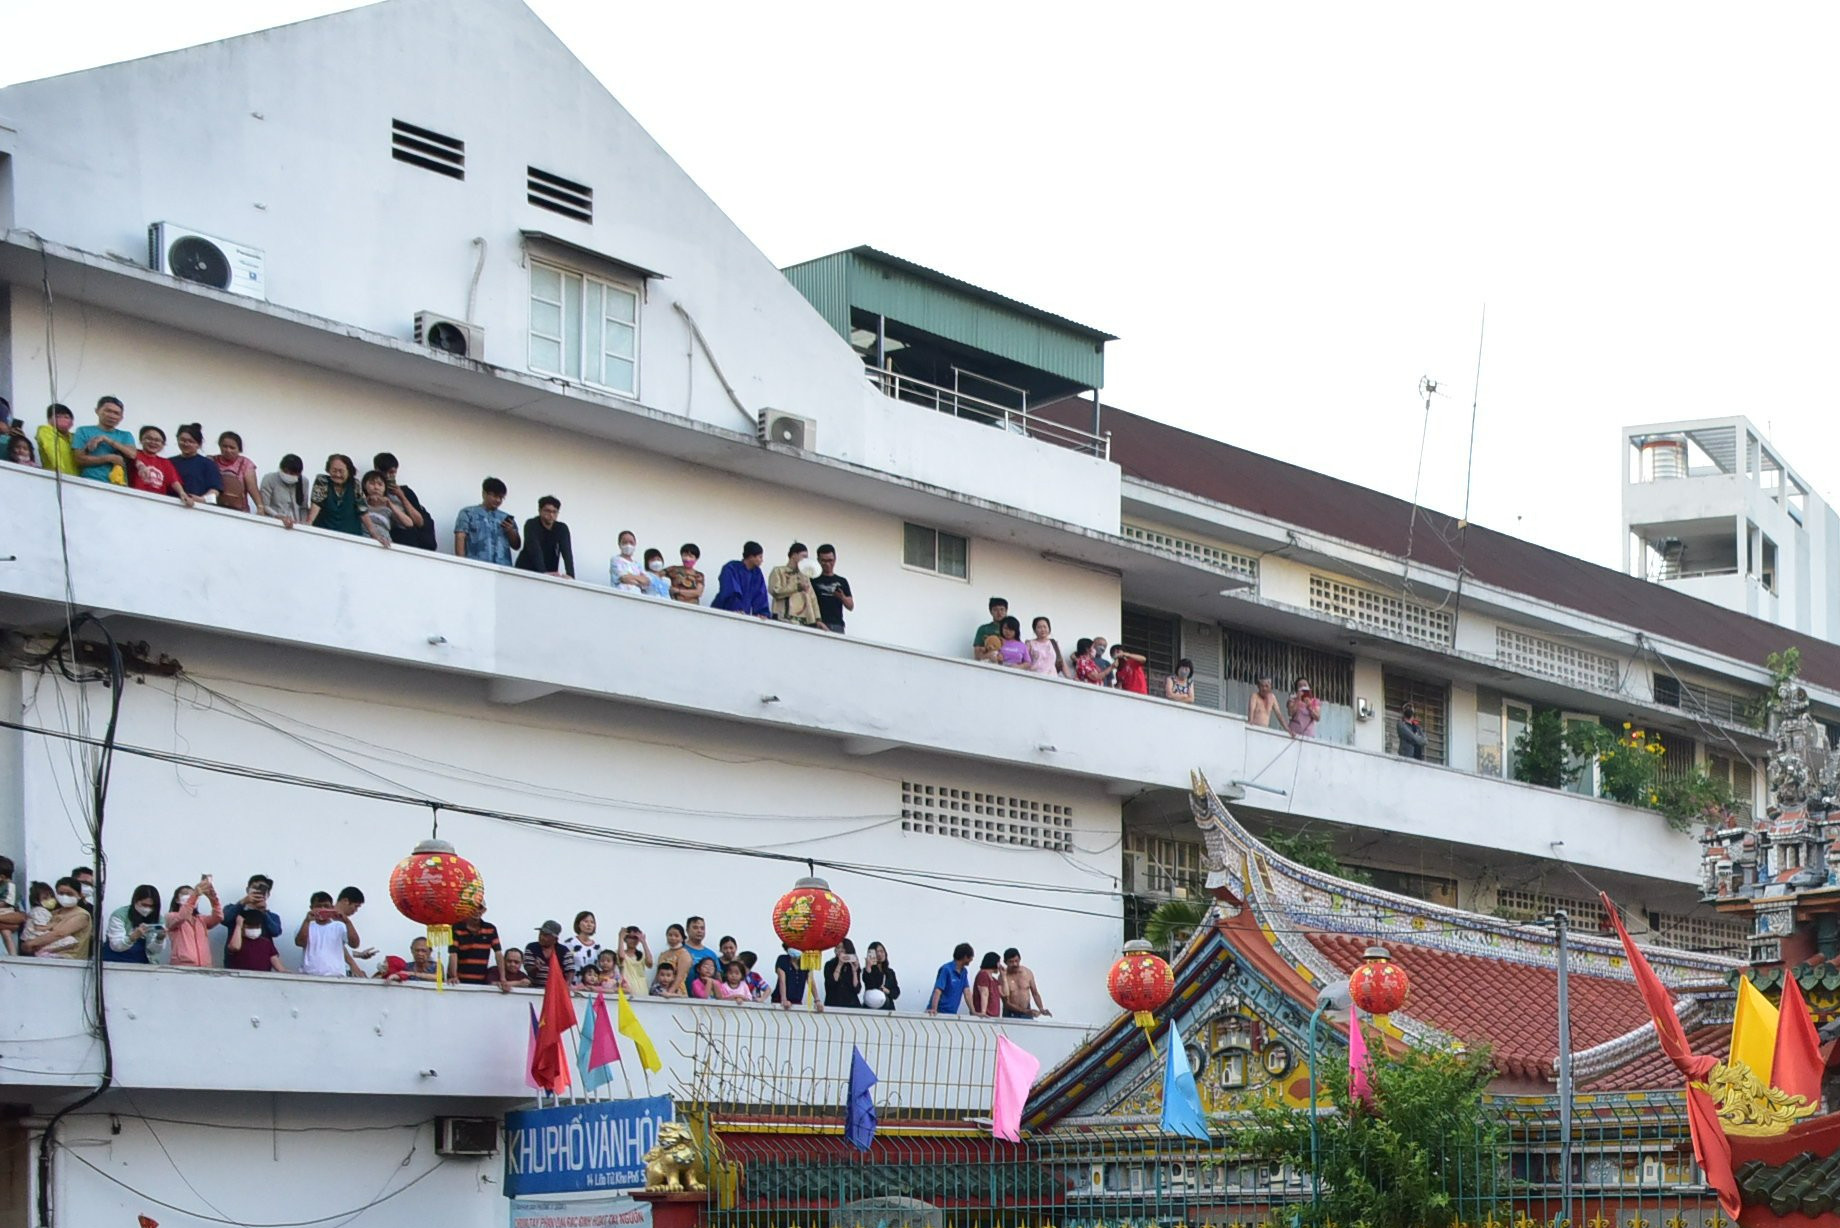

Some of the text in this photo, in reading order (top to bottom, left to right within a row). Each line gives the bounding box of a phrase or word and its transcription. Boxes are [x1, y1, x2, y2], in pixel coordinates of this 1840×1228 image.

[508, 1127, 546, 1175] KHU
[546, 1113, 584, 1172] PHỐ
[585, 1113, 625, 1169] VĂN
